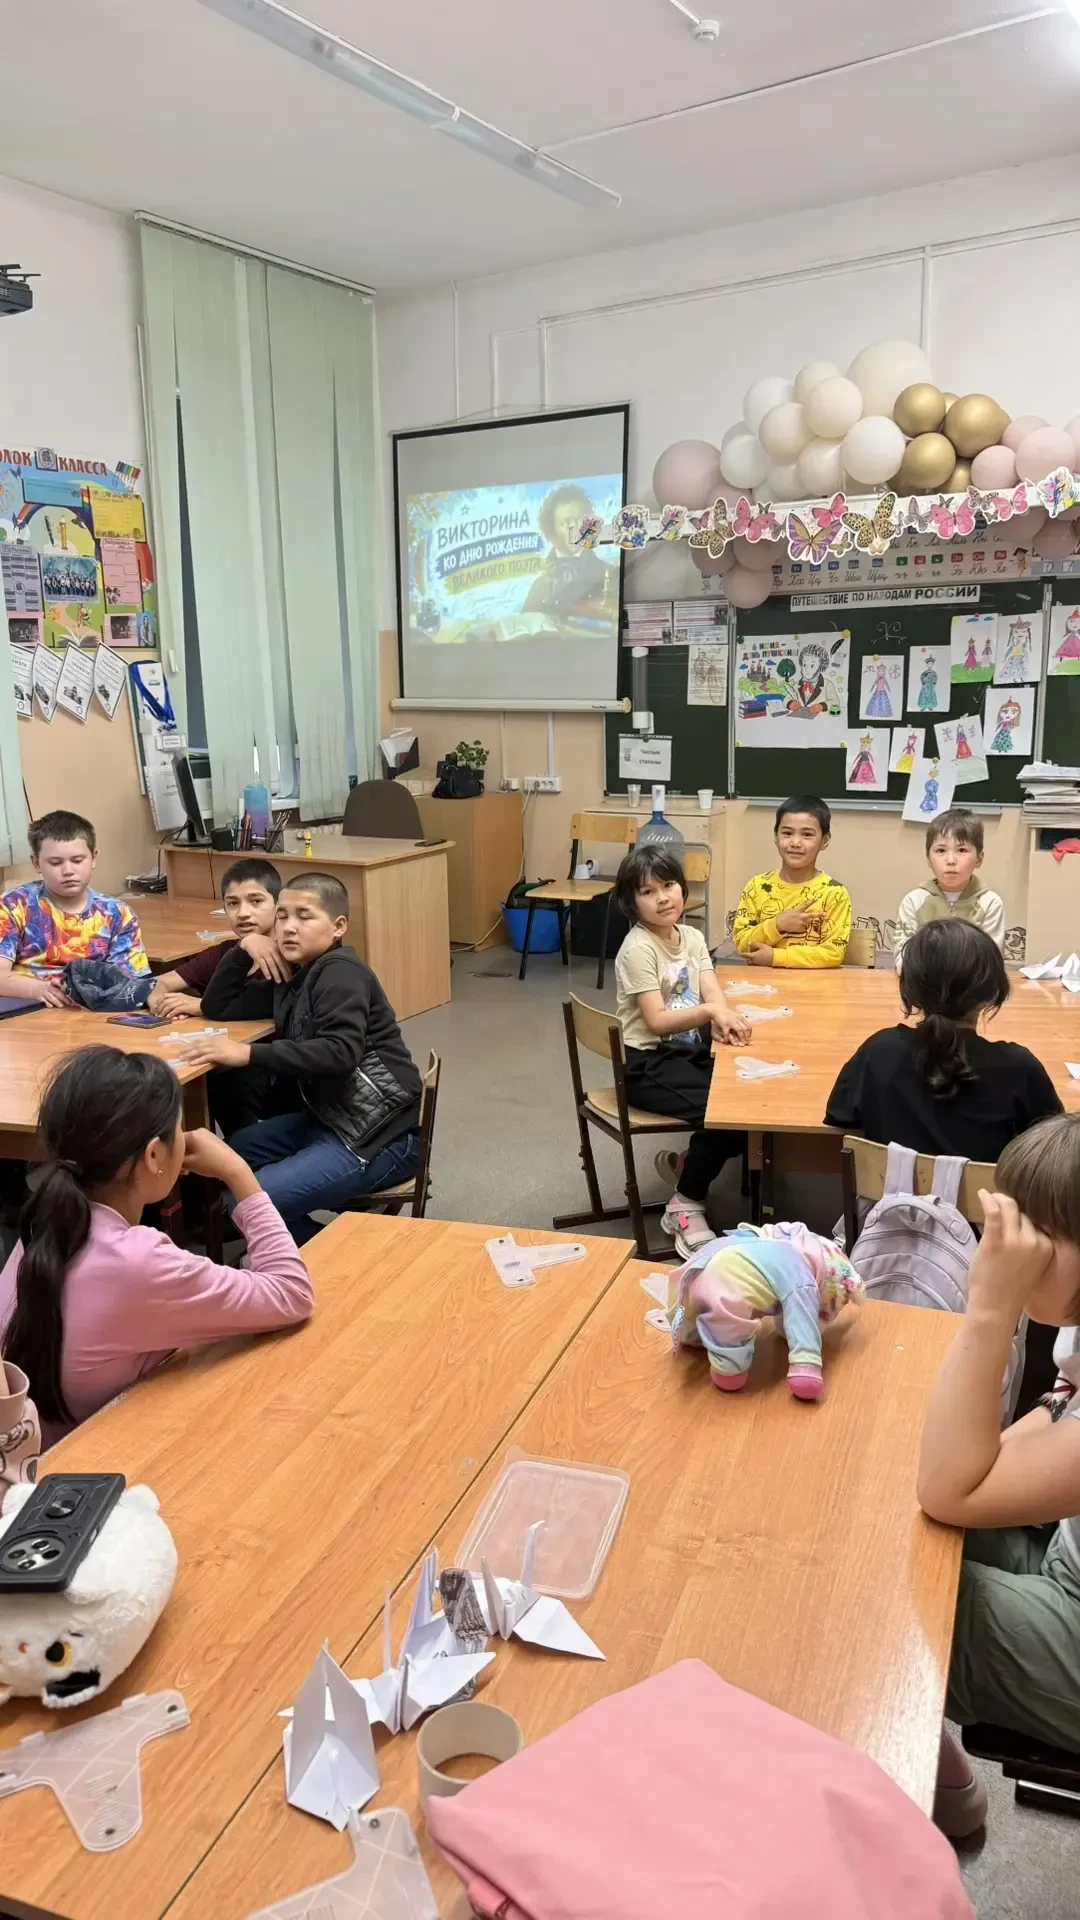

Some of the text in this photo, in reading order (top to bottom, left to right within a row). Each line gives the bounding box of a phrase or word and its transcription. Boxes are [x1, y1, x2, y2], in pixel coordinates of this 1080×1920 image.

[58, 457, 108, 476] КЛАССА
[437, 509, 530, 549] ВИКТОРИНА
[443, 535, 538, 572] КО ДНЮ РОЖДЕНИЯ
[452, 556, 540, 590] ВЕЛИКОГО ПОЭТА
[792, 586, 977, 607] ПУТЕШЕСТВИЕ ПО НАРОДАМ РОССИИ
